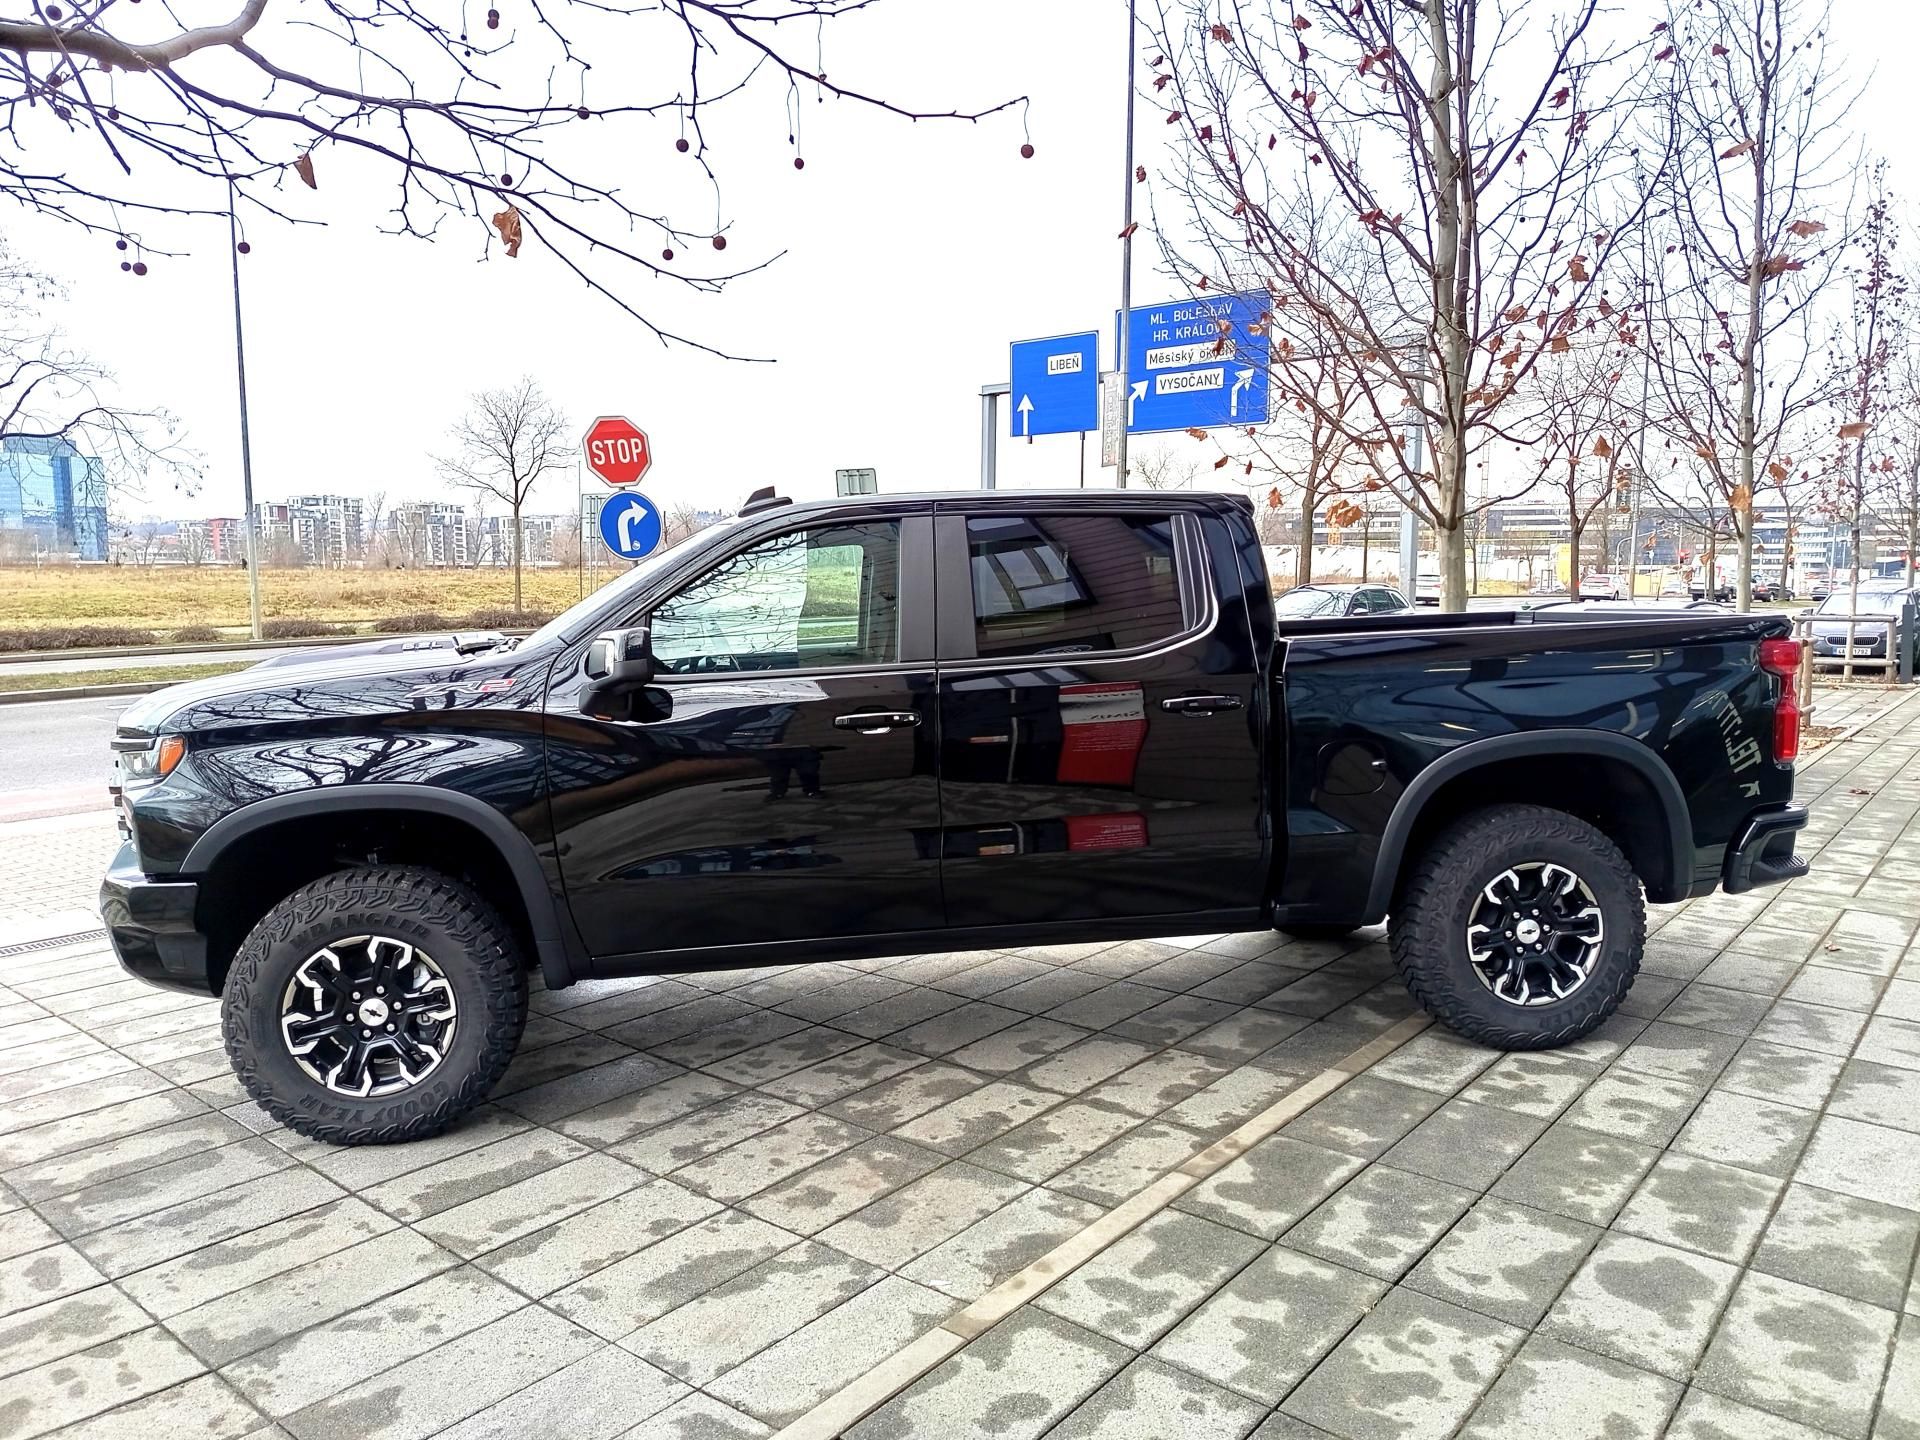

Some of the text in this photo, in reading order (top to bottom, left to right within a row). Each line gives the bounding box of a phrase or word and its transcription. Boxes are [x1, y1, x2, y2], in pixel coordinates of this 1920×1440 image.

[1150, 302, 1233, 326] ML. BOLESLAV
[1153, 322, 1229, 343] HR. KRÁLOV
[1050, 354, 1080, 371] LIBEŇ
[1159, 372, 1221, 391] VYSOČANY
[591, 437, 643, 466] STOP
[403, 678, 519, 700] ZR2
